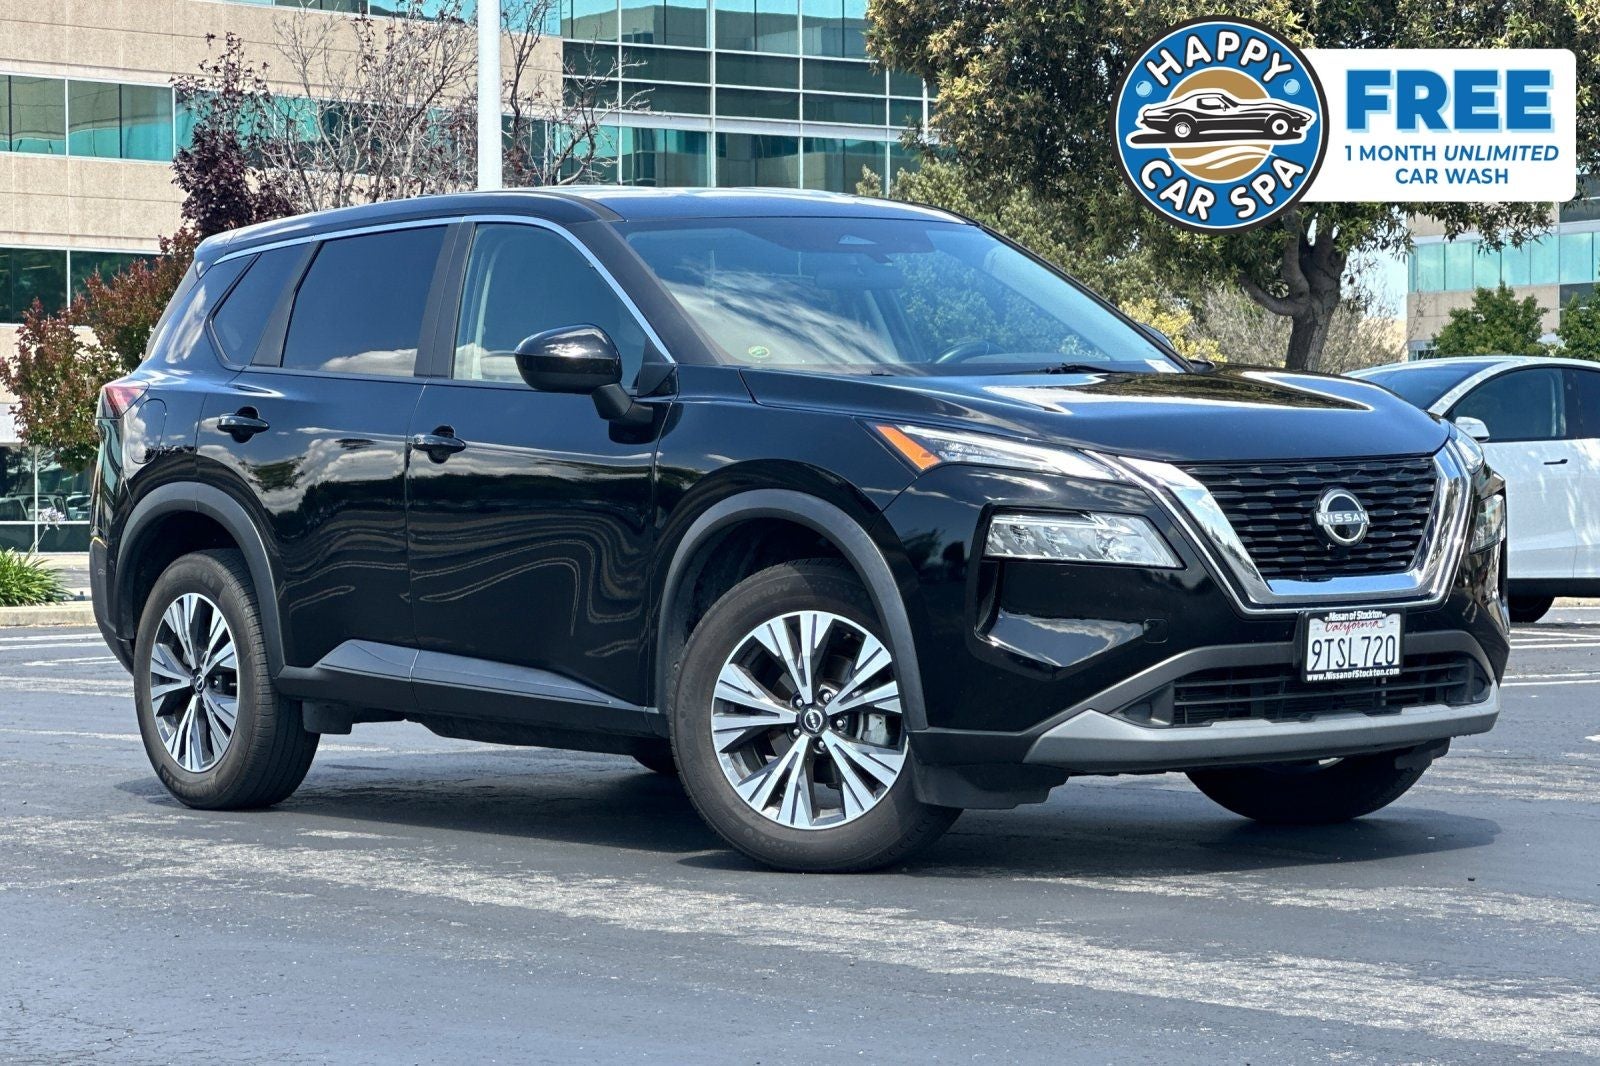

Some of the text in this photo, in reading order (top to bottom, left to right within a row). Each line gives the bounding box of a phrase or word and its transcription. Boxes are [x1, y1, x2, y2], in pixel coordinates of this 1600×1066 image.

[1319, 513, 1368, 523] NISSAN
[1329, 610, 1382, 621] Nissan of Stockton
[1325, 620, 1382, 635] California
[1312, 635, 1396, 670] 9TSL720
[1307, 668, 1400, 681] www.NissanofStockton.com
